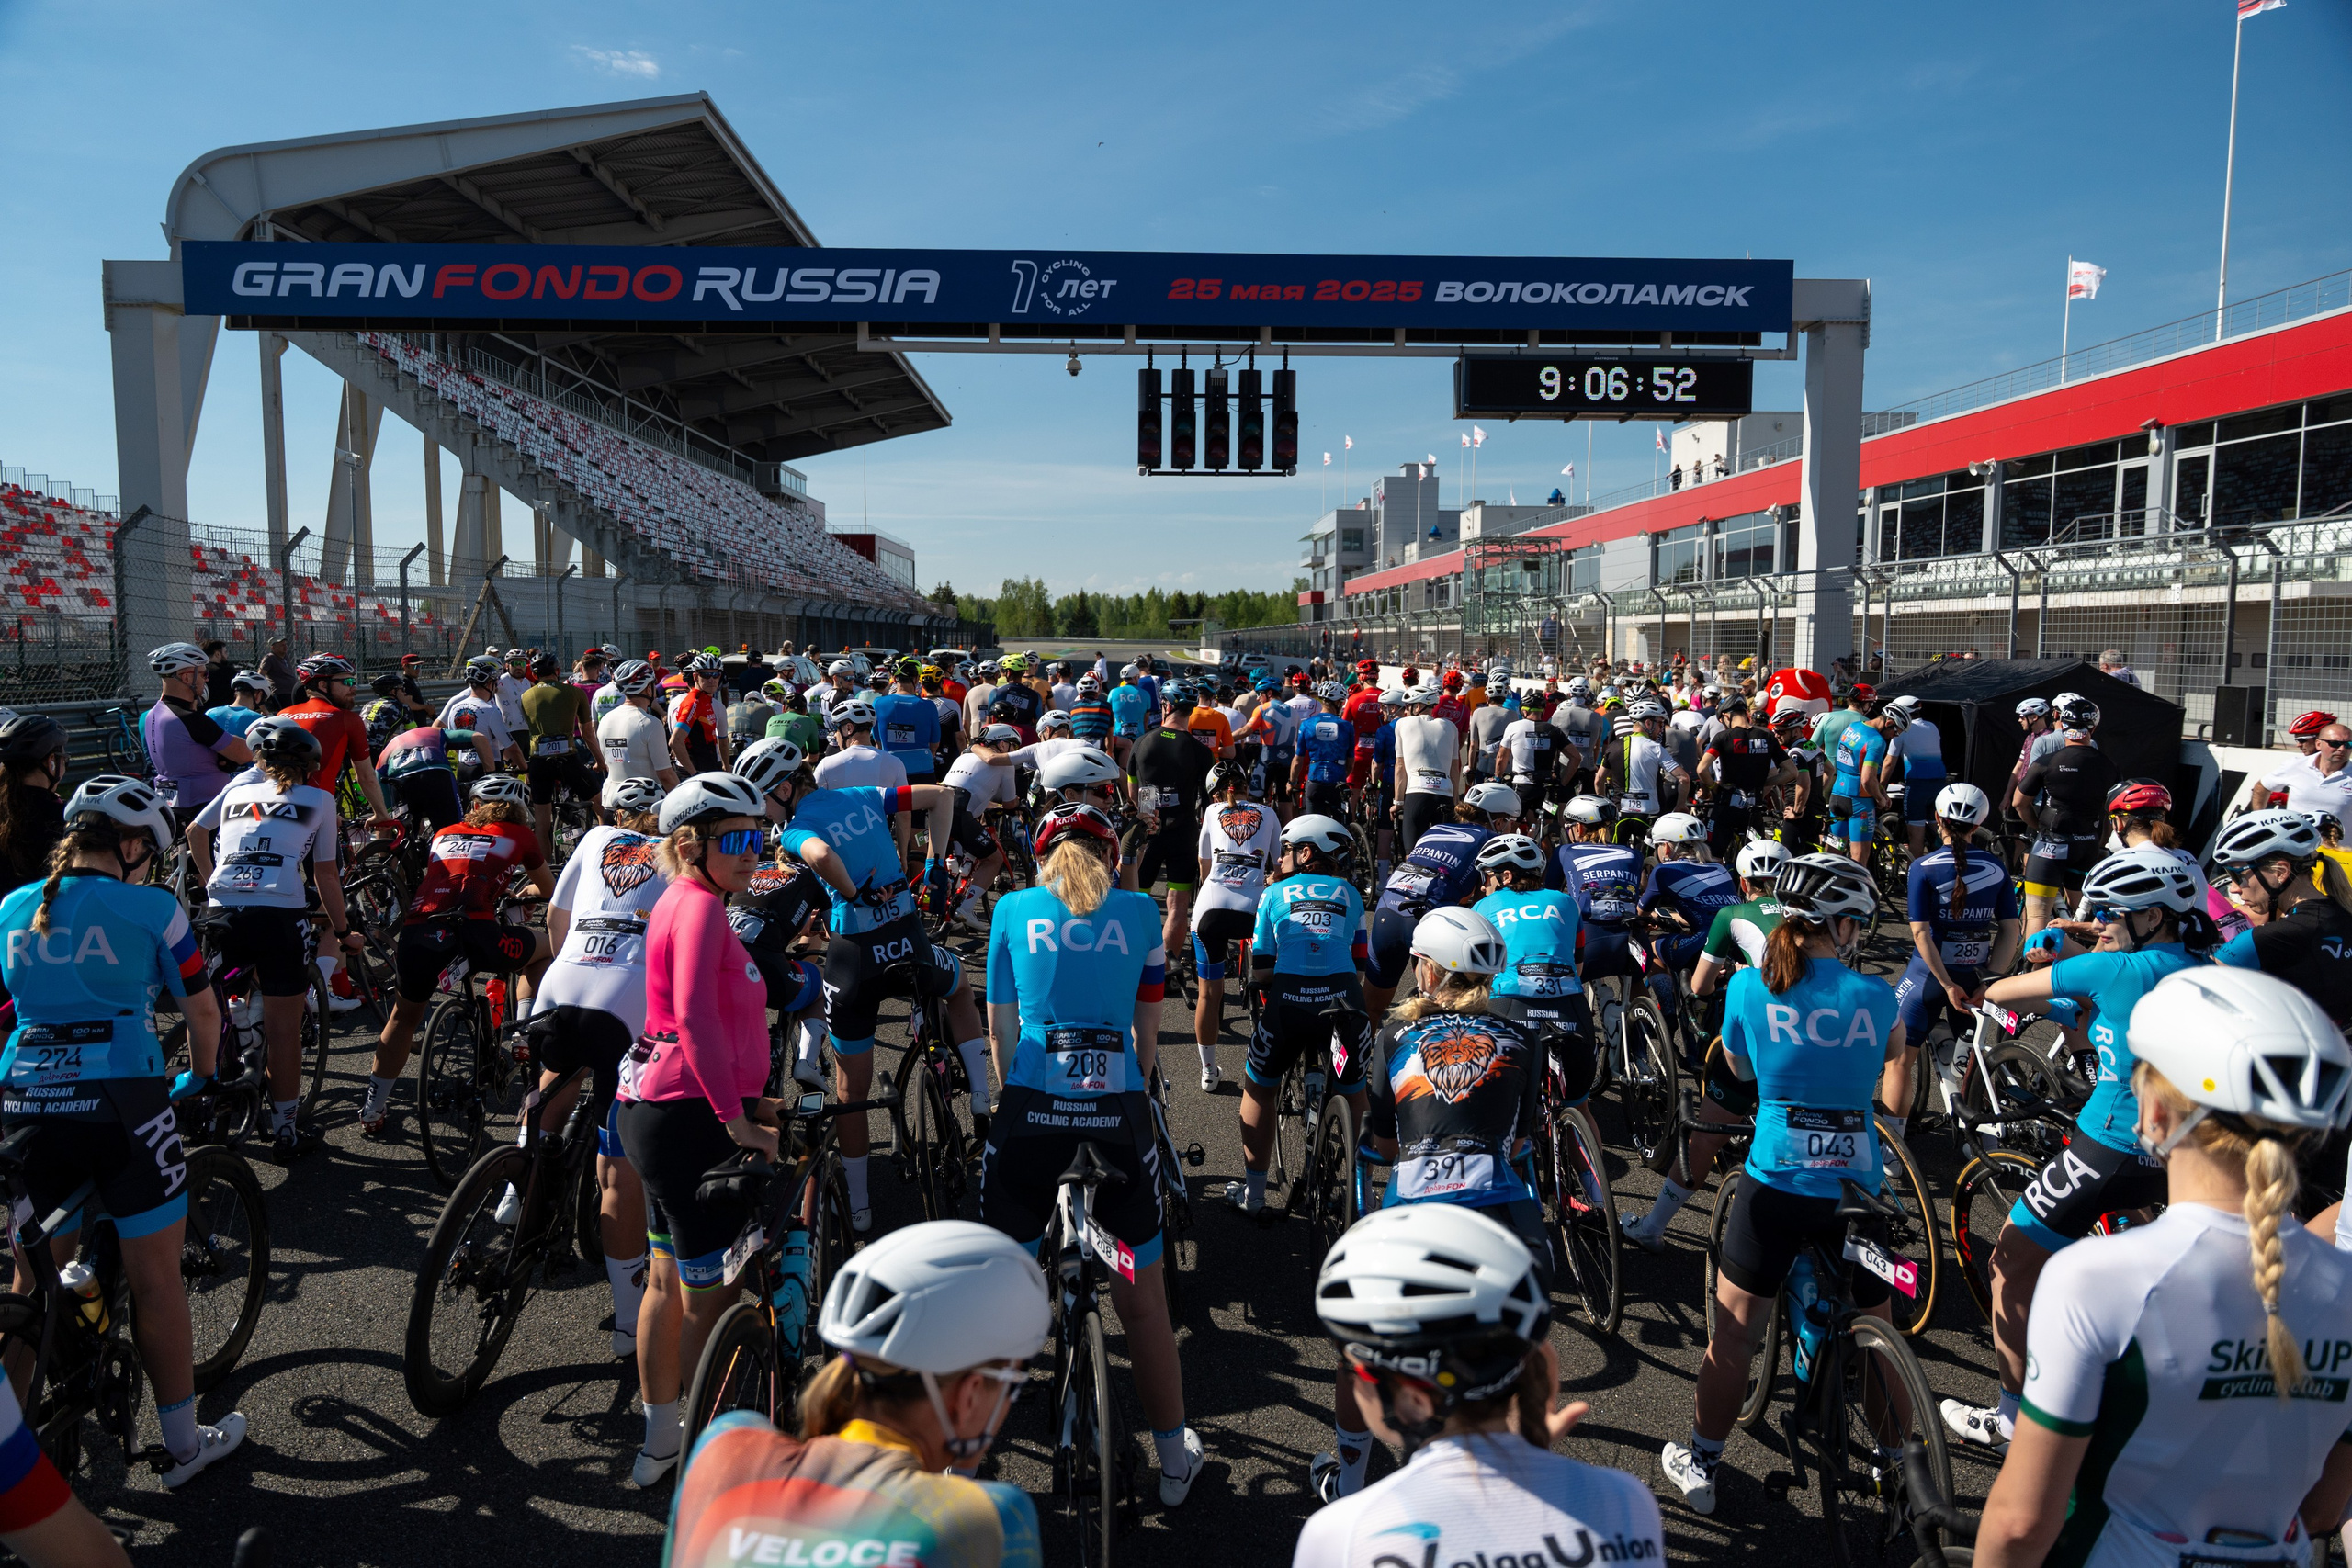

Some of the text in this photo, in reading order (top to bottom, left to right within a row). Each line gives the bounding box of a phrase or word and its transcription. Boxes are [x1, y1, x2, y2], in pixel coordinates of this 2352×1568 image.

[1041, 259, 1091, 283] CYCLING
[232, 262, 941, 311] GRAN FONDO RUSSIA
[1057, 279, 1117, 299] лет
[1167, 278, 1755, 307] 25 мая 2025 ВОЛОКОЛАМСК
[1040, 292, 1091, 316] FOR ALL
[1539, 366, 1697, 402] 9:06:52
[597, 695, 621, 705] KMT
[1119, 693, 1142, 704] RCA
[894, 731, 907, 739] 192
[547, 742, 560, 751] 201
[1425, 777, 1442, 785] 335
[228, 802, 299, 822] LAVA
[666, 798, 708, 831] S-WORKS
[1056, 816, 1078, 826] KASK
[2260, 815, 2294, 826] KASK
[825, 804, 883, 848] RCA
[447, 841, 473, 853] 241
[2042, 843, 2057, 854] 162
[232, 866, 264, 881] 263
[1223, 865, 1248, 880] 202
[1582, 869, 1638, 884] SERPANTIN
[2152, 866, 2183, 875] KASK
[1283, 883, 1351, 908] RCA
[1496, 904, 1566, 928] RCA
[1604, 900, 1626, 914] 315
[1301, 912, 1332, 927] 203
[584, 935, 617, 955] 016
[1026, 918, 1129, 955] RCA
[7, 925, 119, 970] RCA
[872, 937, 914, 964] RCA
[1953, 942, 1979, 958] 285
[930, 944, 956, 972] RCA
[1300, 986, 1330, 994] RUSSIAN
[1534, 977, 1563, 995] 331
[1283, 992, 1313, 1003] CYCLING
[1527, 1009, 1559, 1019] RUSSIAN
[2007, 1015, 2016, 1027] D
[73, 1027, 90, 1035] 100
[1766, 1002, 1878, 1048] RCA
[1246, 1020, 1274, 1073] RCA
[2095, 1024, 2118, 1082] RCA
[34, 1046, 82, 1072] 274
[1066, 1052, 1108, 1078] 208
[26, 1086, 75, 1098] RUSSIAN
[3, 1098, 101, 1113] CYCLING ACADEMY
[1053, 1100, 1097, 1112] RUSSIAN
[1027, 1111, 1122, 1128] CYCLING ACADEMY
[1792, 1116, 1828, 1124] FONDO
[134, 1105, 187, 1197] RCA
[1807, 1133, 1856, 1158] 043
[1424, 1156, 1466, 1181] 391
[2023, 1148, 2101, 1219] RCA
[1119, 1250, 1133, 1270] D
[1865, 1250, 1887, 1274] 043
[1895, 1264, 1915, 1285] D
[2207, 1337, 2272, 1373] Ski
[729, 1526, 922, 1567] VELOCE
